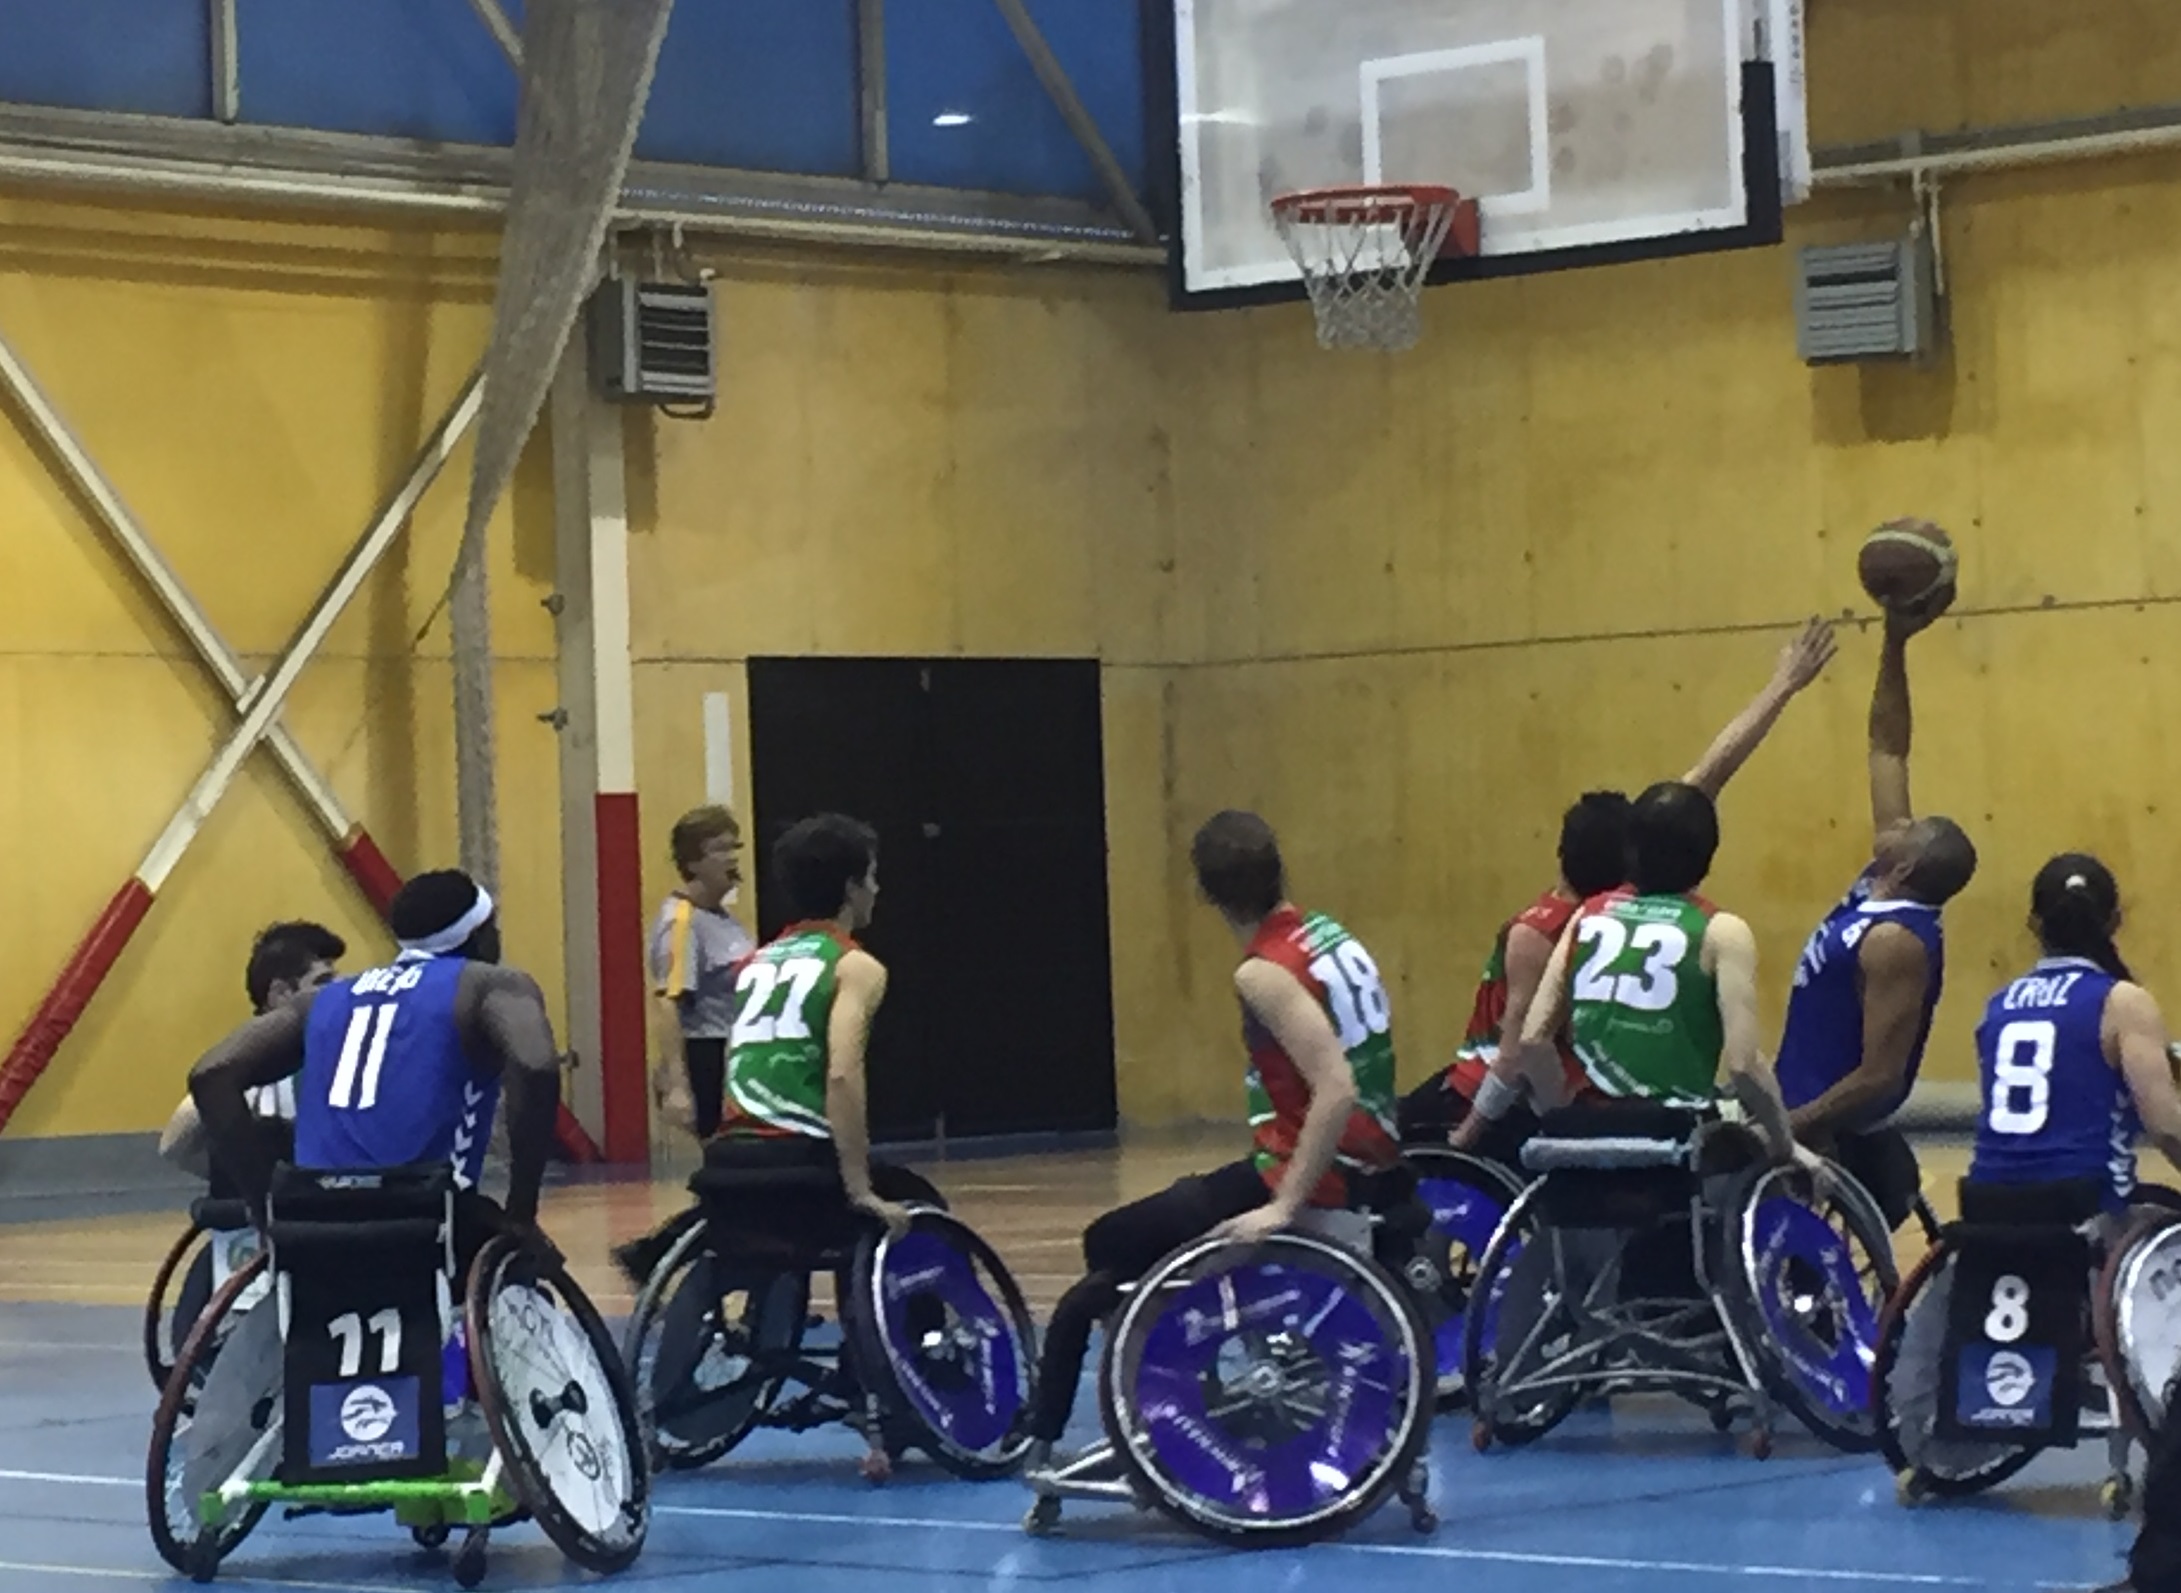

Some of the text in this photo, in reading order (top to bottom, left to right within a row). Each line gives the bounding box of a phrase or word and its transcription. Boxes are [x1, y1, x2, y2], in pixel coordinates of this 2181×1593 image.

[730, 958, 826, 1048] 27
[1308, 940, 1391, 1048] 18
[1573, 915, 1688, 1010] 23
[2003, 972, 2083, 1010] CRUZ
[329, 1003, 398, 1109] 11
[1989, 1020, 2056, 1134] 8
[327, 1308, 401, 1377] 11
[1984, 1275, 2030, 1342] 8
